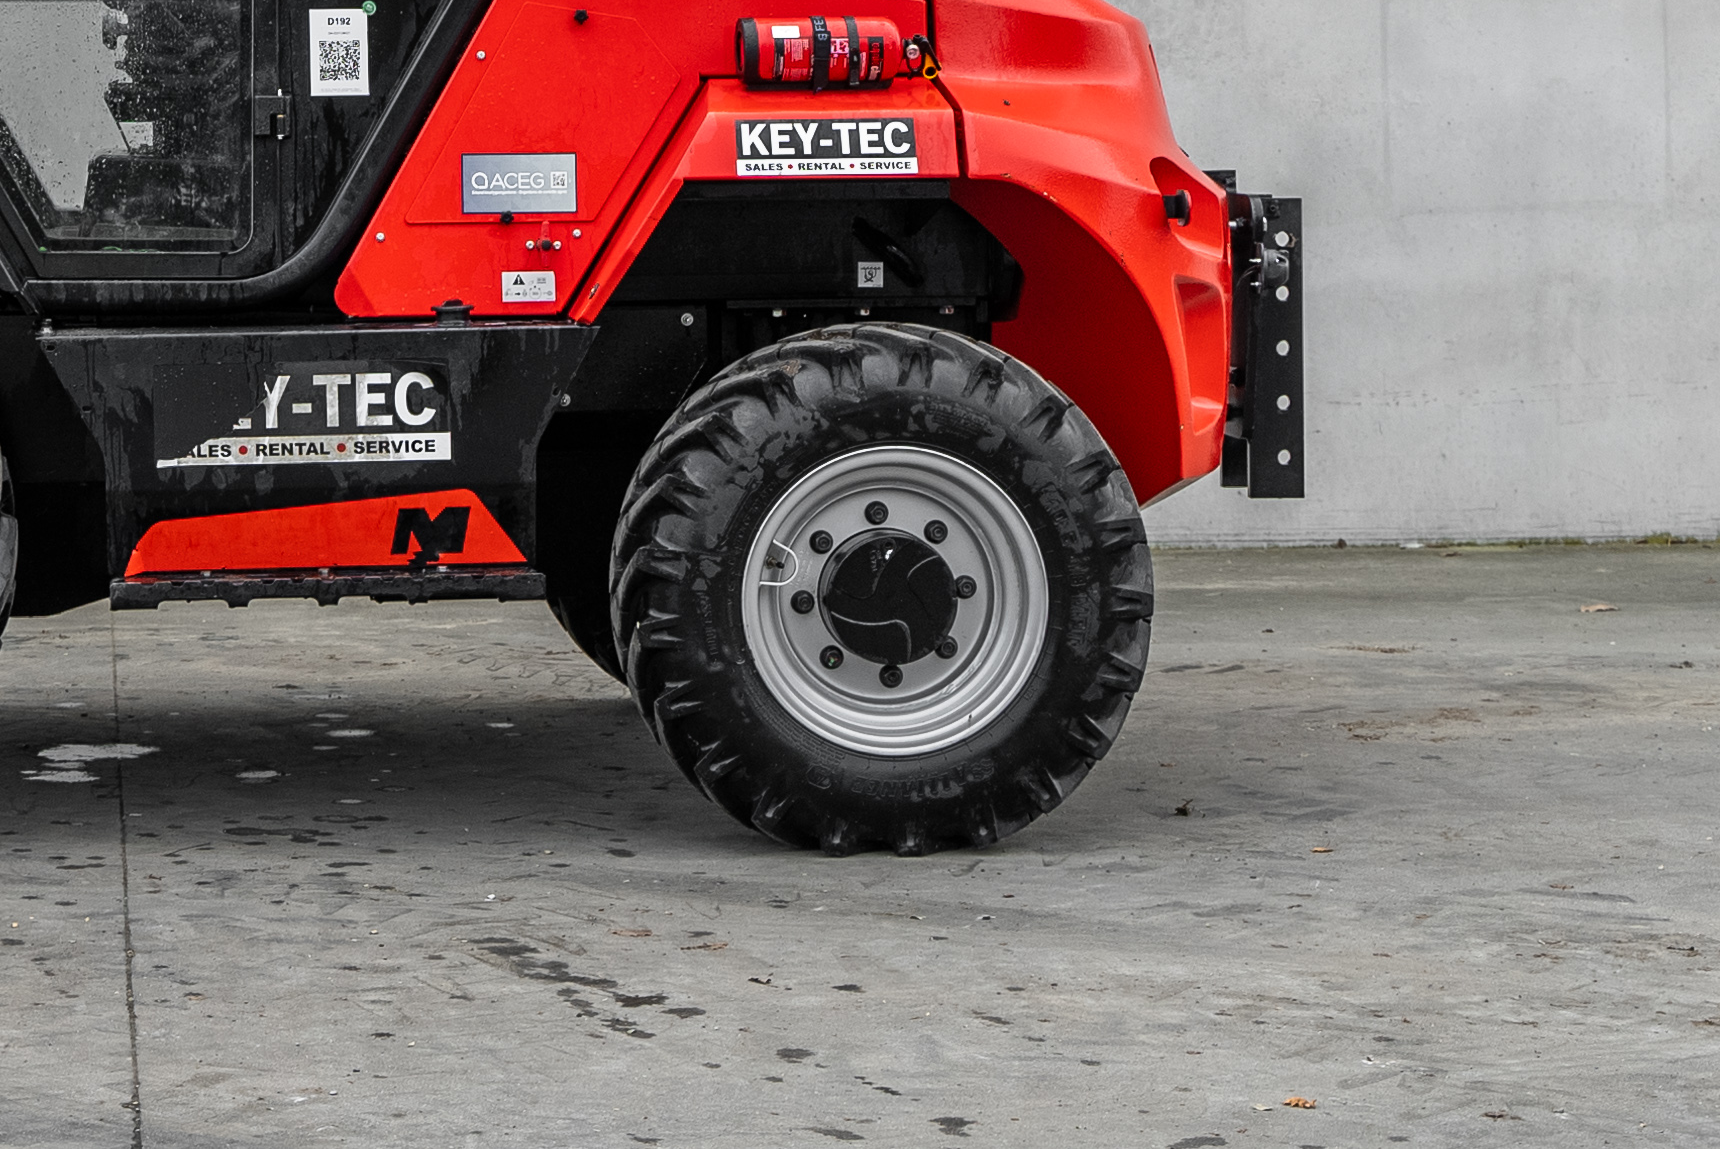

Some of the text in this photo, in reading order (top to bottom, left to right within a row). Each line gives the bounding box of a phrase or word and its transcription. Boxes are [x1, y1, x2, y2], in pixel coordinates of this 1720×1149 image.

[327, 17, 351, 26] D192
[740, 121, 911, 156] KEY-TEC
[745, 161, 911, 172] SALES RENTAL SERVICE
[489, 172, 545, 189] ACEG
[233, 372, 436, 429] Y-TEC
[255, 442, 331, 457] RENTAL
[353, 439, 436, 455] SERVICE
[391, 506, 471, 555] M
